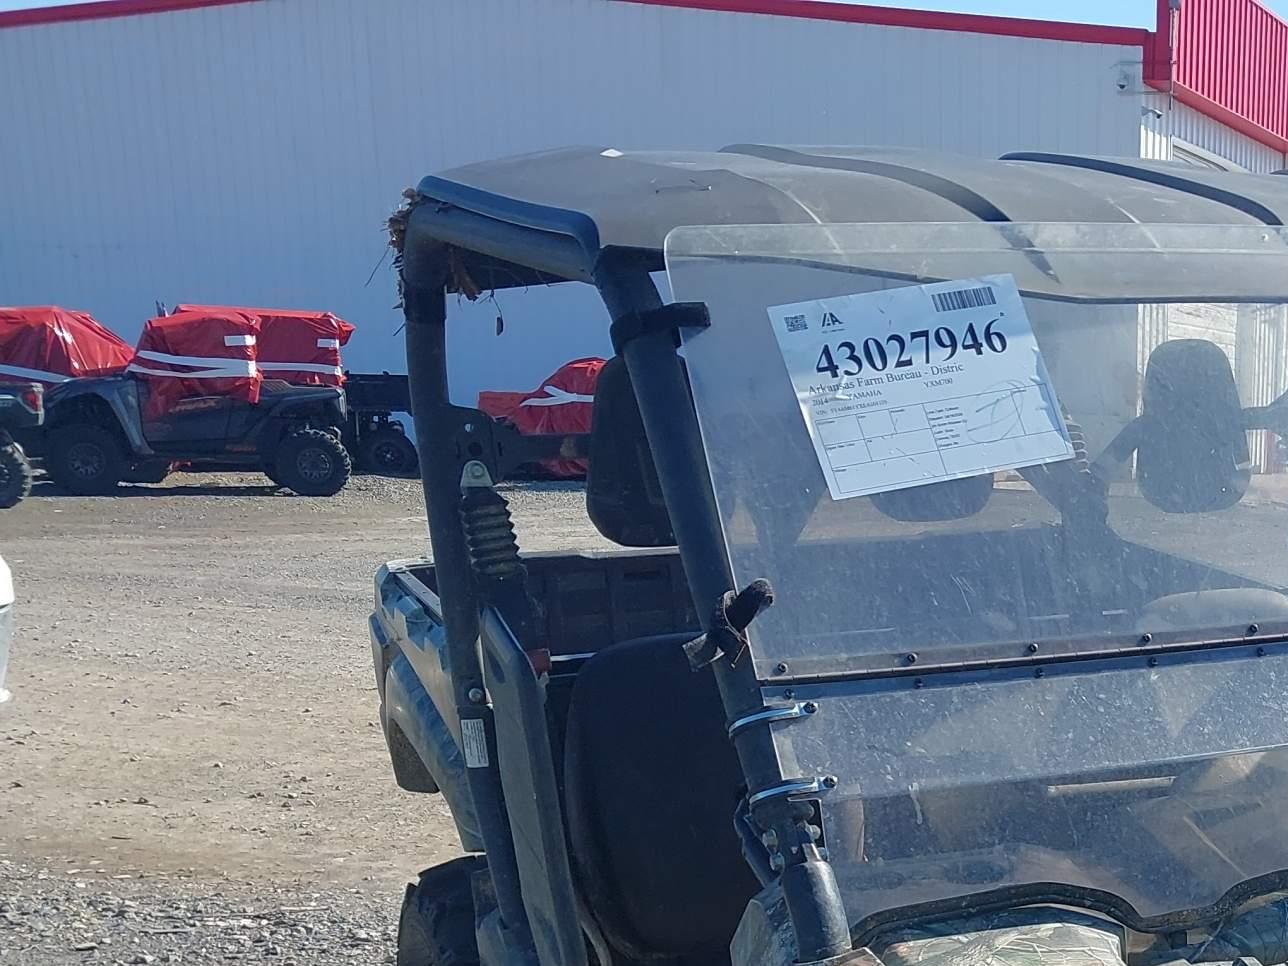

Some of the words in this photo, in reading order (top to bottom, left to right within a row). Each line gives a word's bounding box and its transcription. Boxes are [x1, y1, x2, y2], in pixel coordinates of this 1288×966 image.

[815, 317, 1008, 379] 43027946
[807, 379, 856, 396] Arkansas
[856, 375, 886, 388] Farm
[885, 369, 923, 384] Bureau
[929, 362, 965, 377] Distric
[847, 389, 883, 401] YAMAHA
